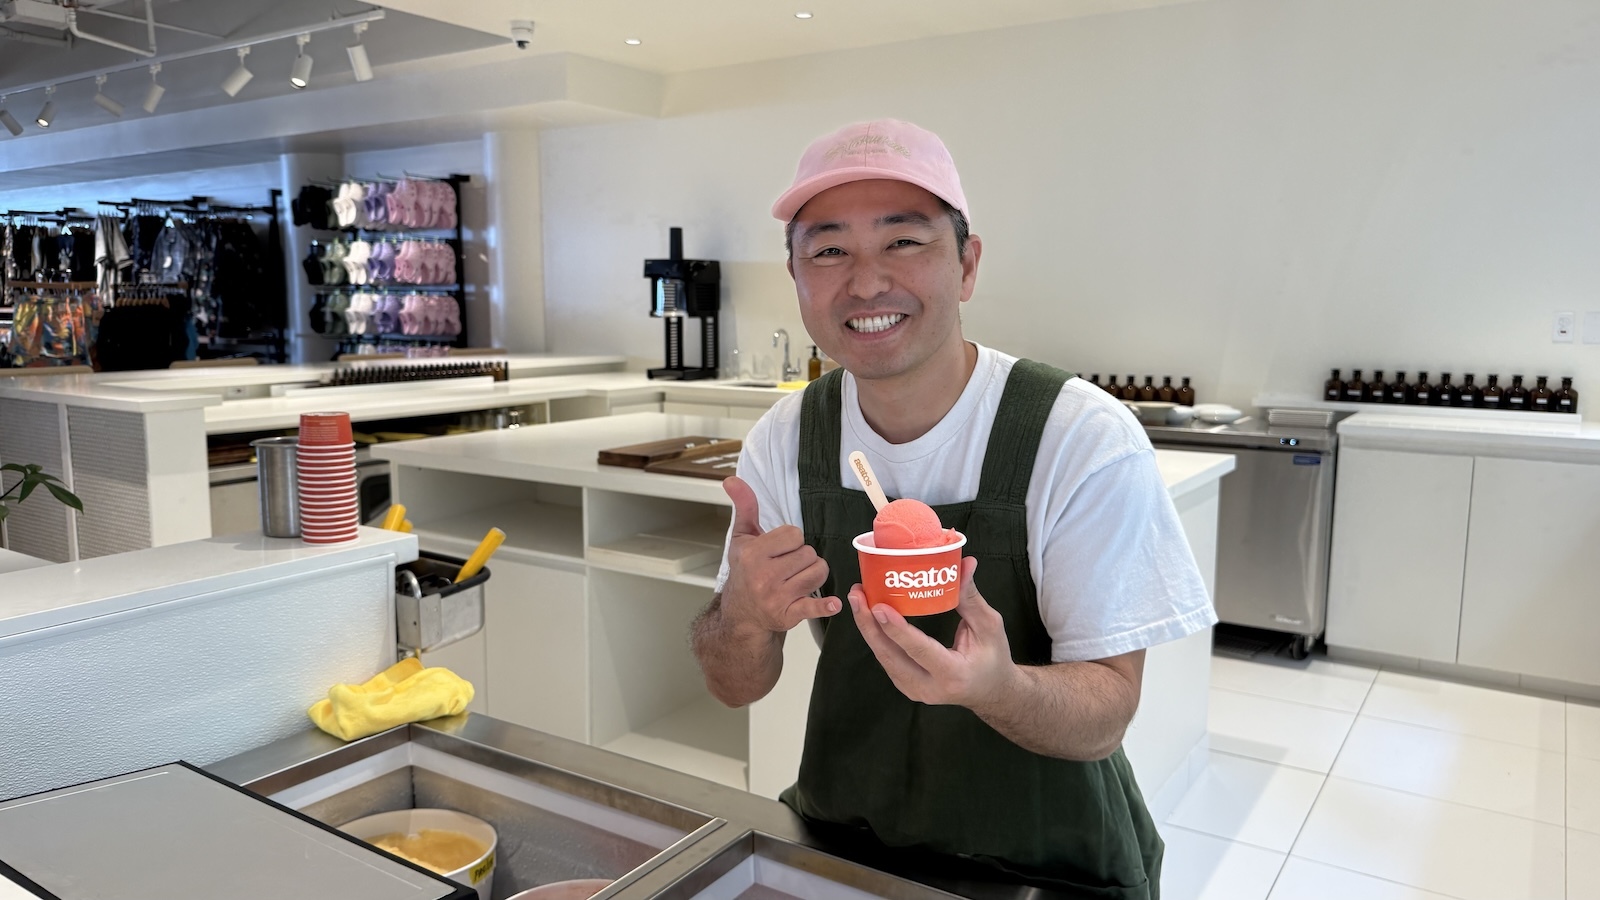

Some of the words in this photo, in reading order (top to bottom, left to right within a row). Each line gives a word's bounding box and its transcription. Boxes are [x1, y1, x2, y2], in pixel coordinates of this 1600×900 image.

[854, 458, 872, 487] asatos
[884, 564, 958, 589] asatos
[907, 588, 944, 599] WAIKIKI
